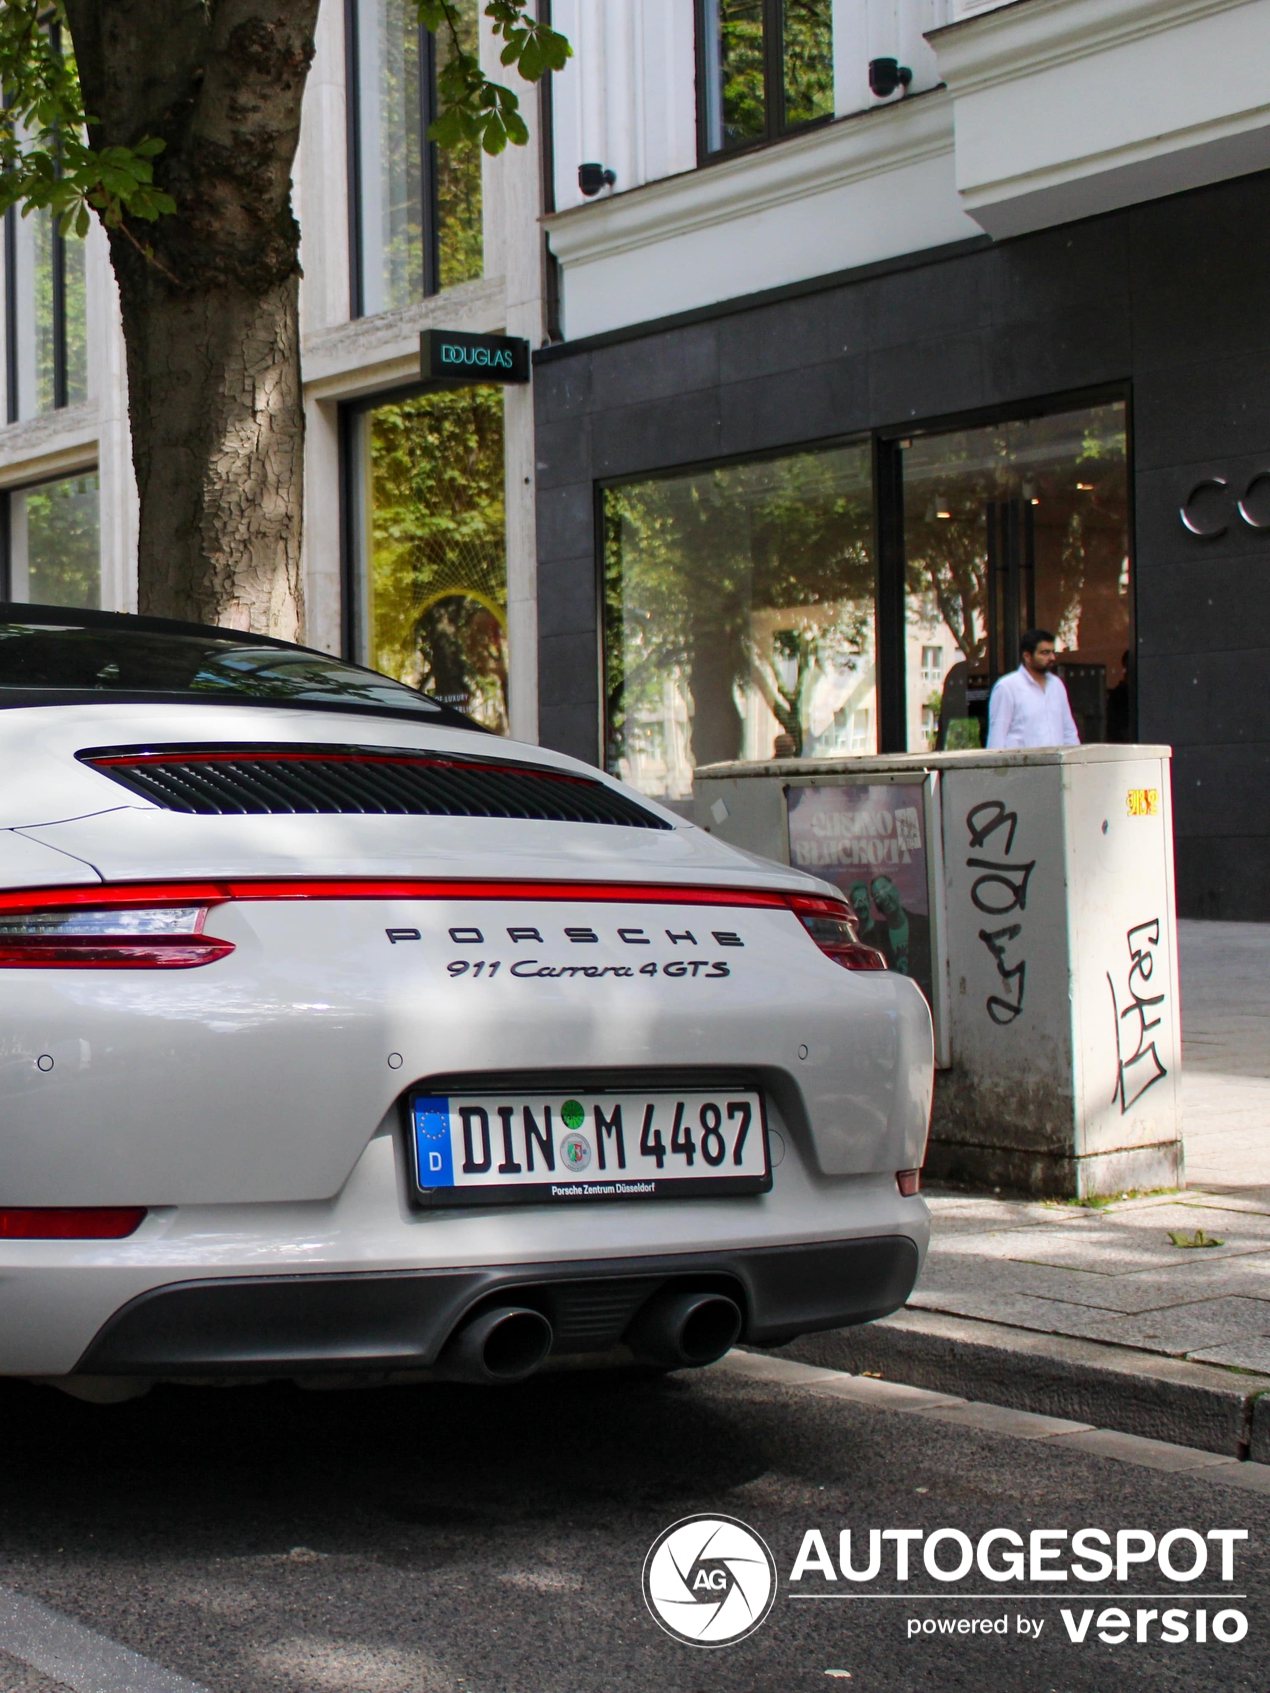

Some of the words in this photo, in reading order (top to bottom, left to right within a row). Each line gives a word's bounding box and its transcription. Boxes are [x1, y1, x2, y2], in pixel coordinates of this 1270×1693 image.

[441, 344, 513, 368] DOUGLAS
[385, 927, 745, 947] PORSCHE
[446, 960, 501, 978] 911
[510, 960, 634, 978] Carrera
[458, 1105, 556, 1174] DIN
[593, 1104, 626, 1170] M
[639, 1101, 752, 1169] 4487
[429, 1152, 442, 1171] D
[551, 1185, 582, 1196] Porsche
[583, 1184, 615, 1195] Zentrum
[615, 1182, 656, 1194] Düsseldorf
